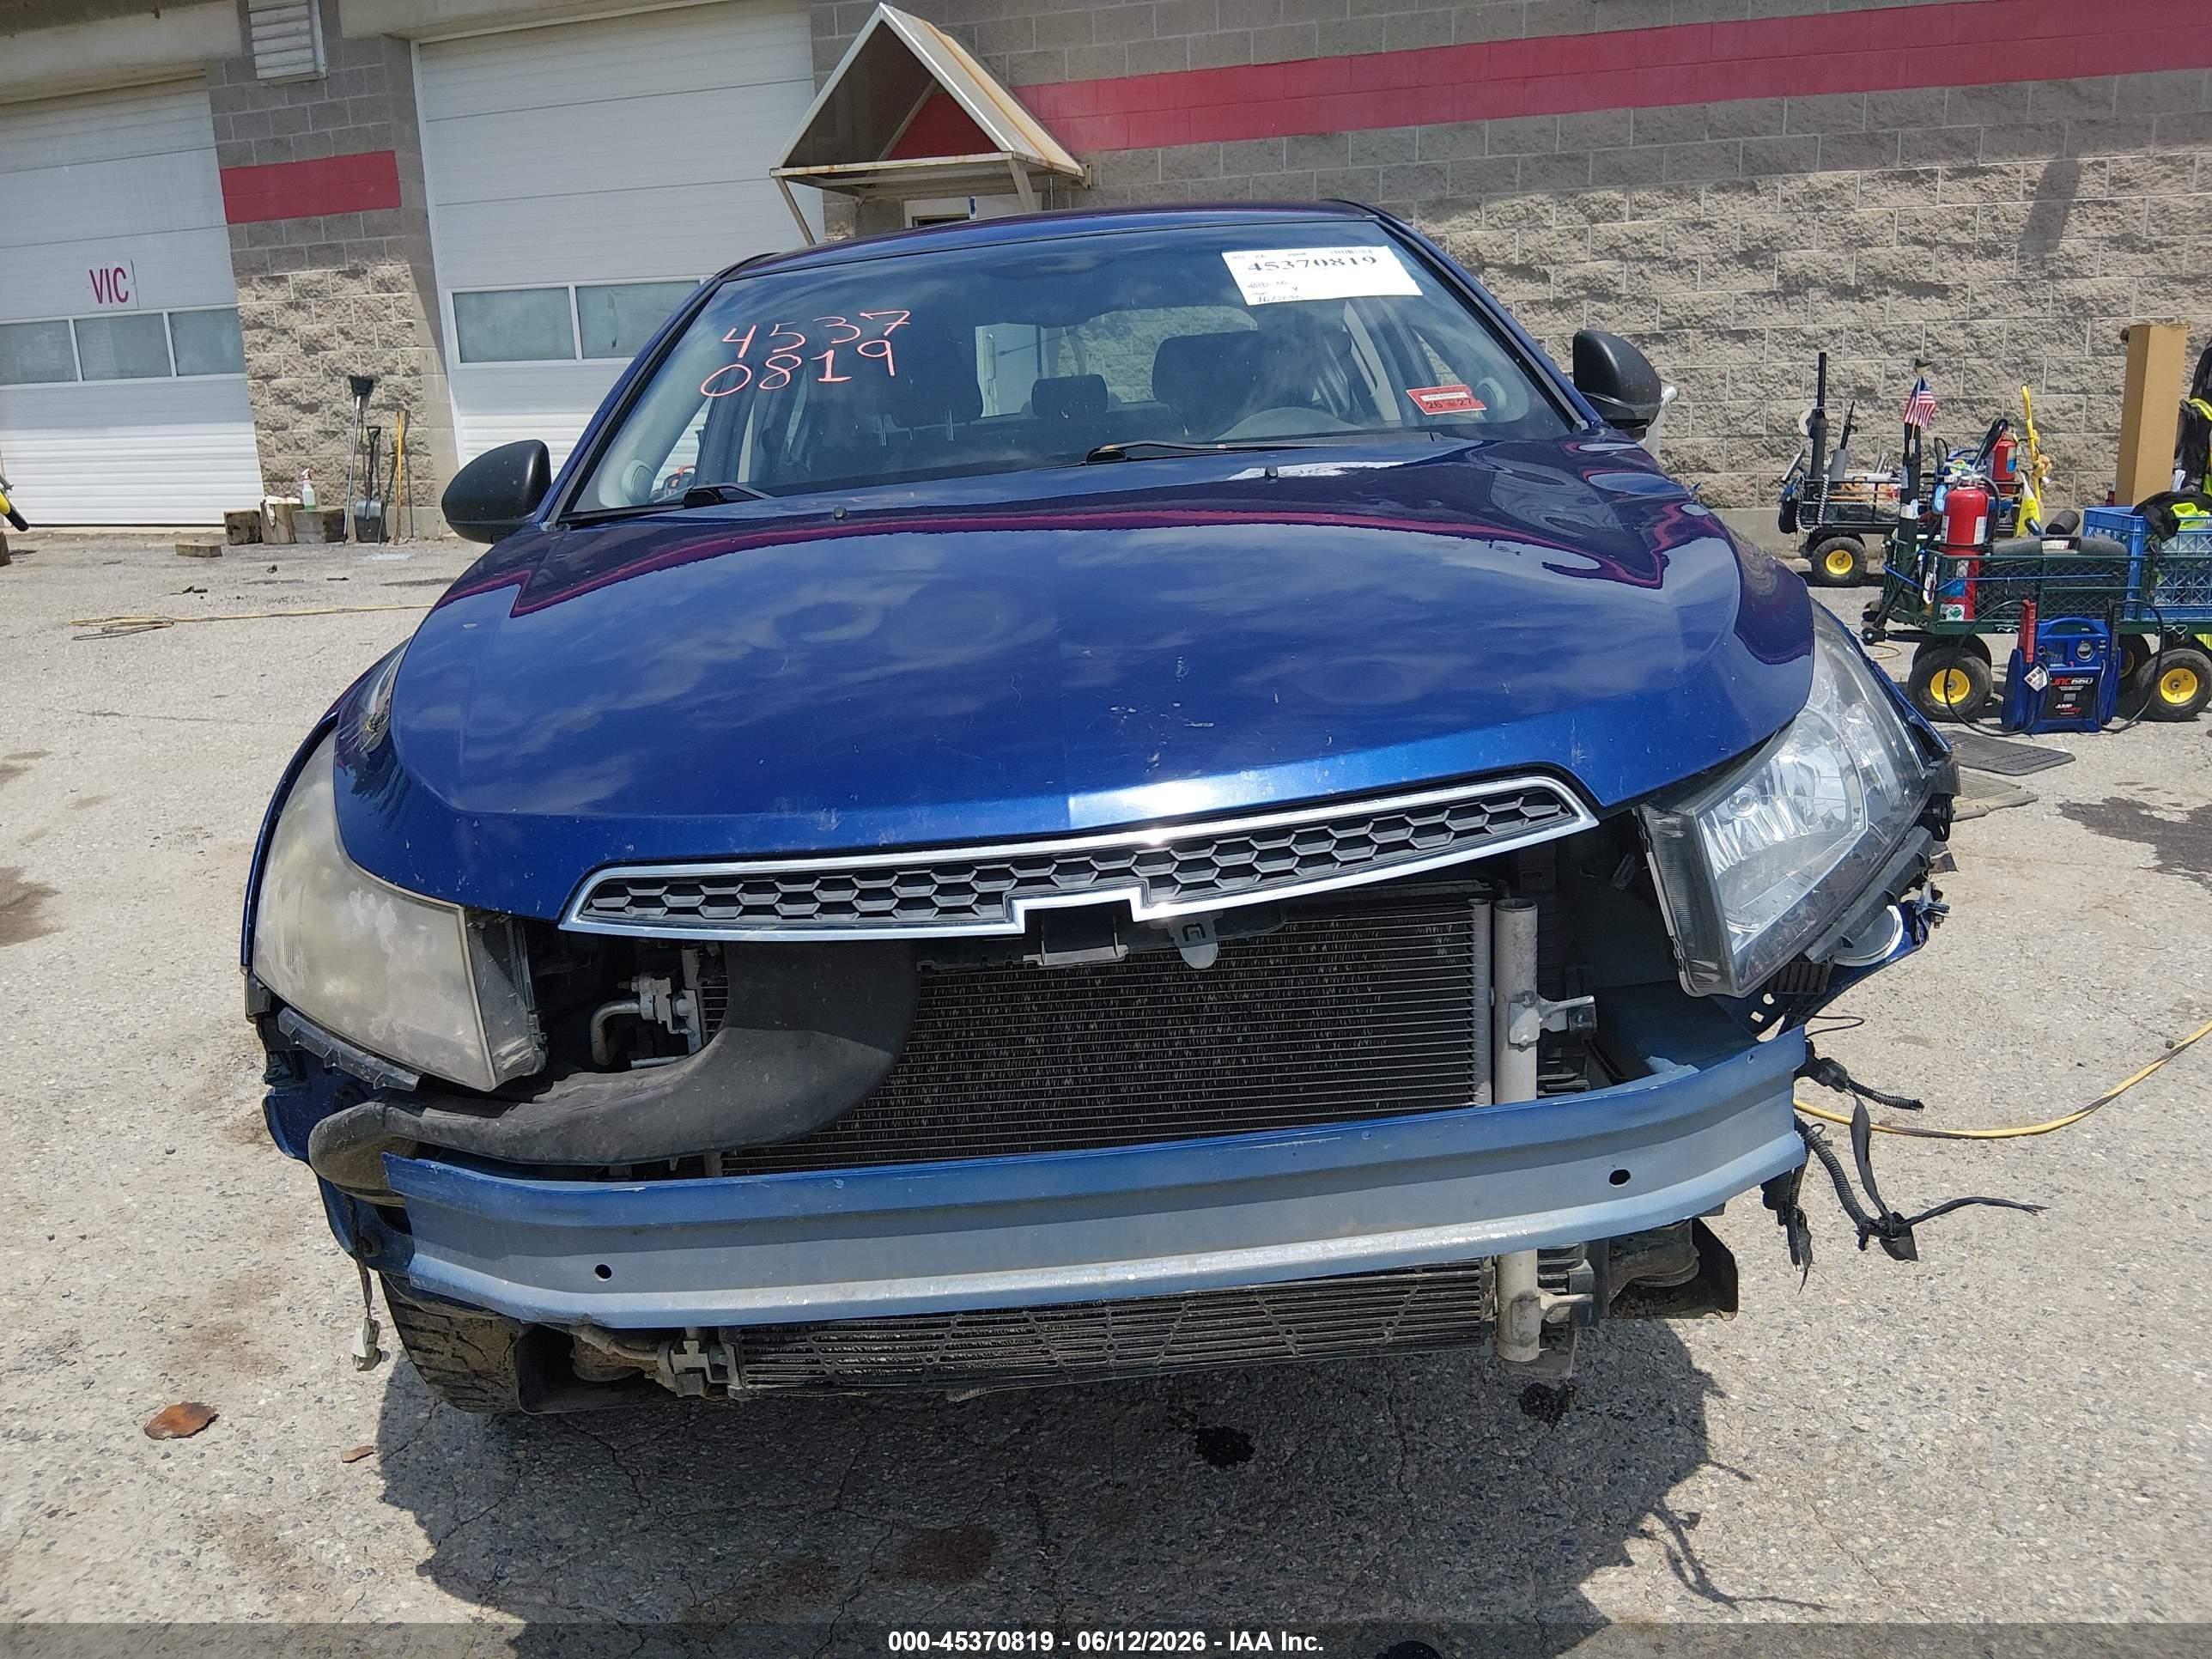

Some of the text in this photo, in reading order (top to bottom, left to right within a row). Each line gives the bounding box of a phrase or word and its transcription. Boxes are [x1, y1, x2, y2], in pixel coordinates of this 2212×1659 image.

[1248, 256, 1377, 271] 45370819
[88, 267, 129, 304] VIC
[722, 310, 910, 359] 4537
[700, 339, 896, 397] 0819
[2051, 677, 2094, 686] JNC660
